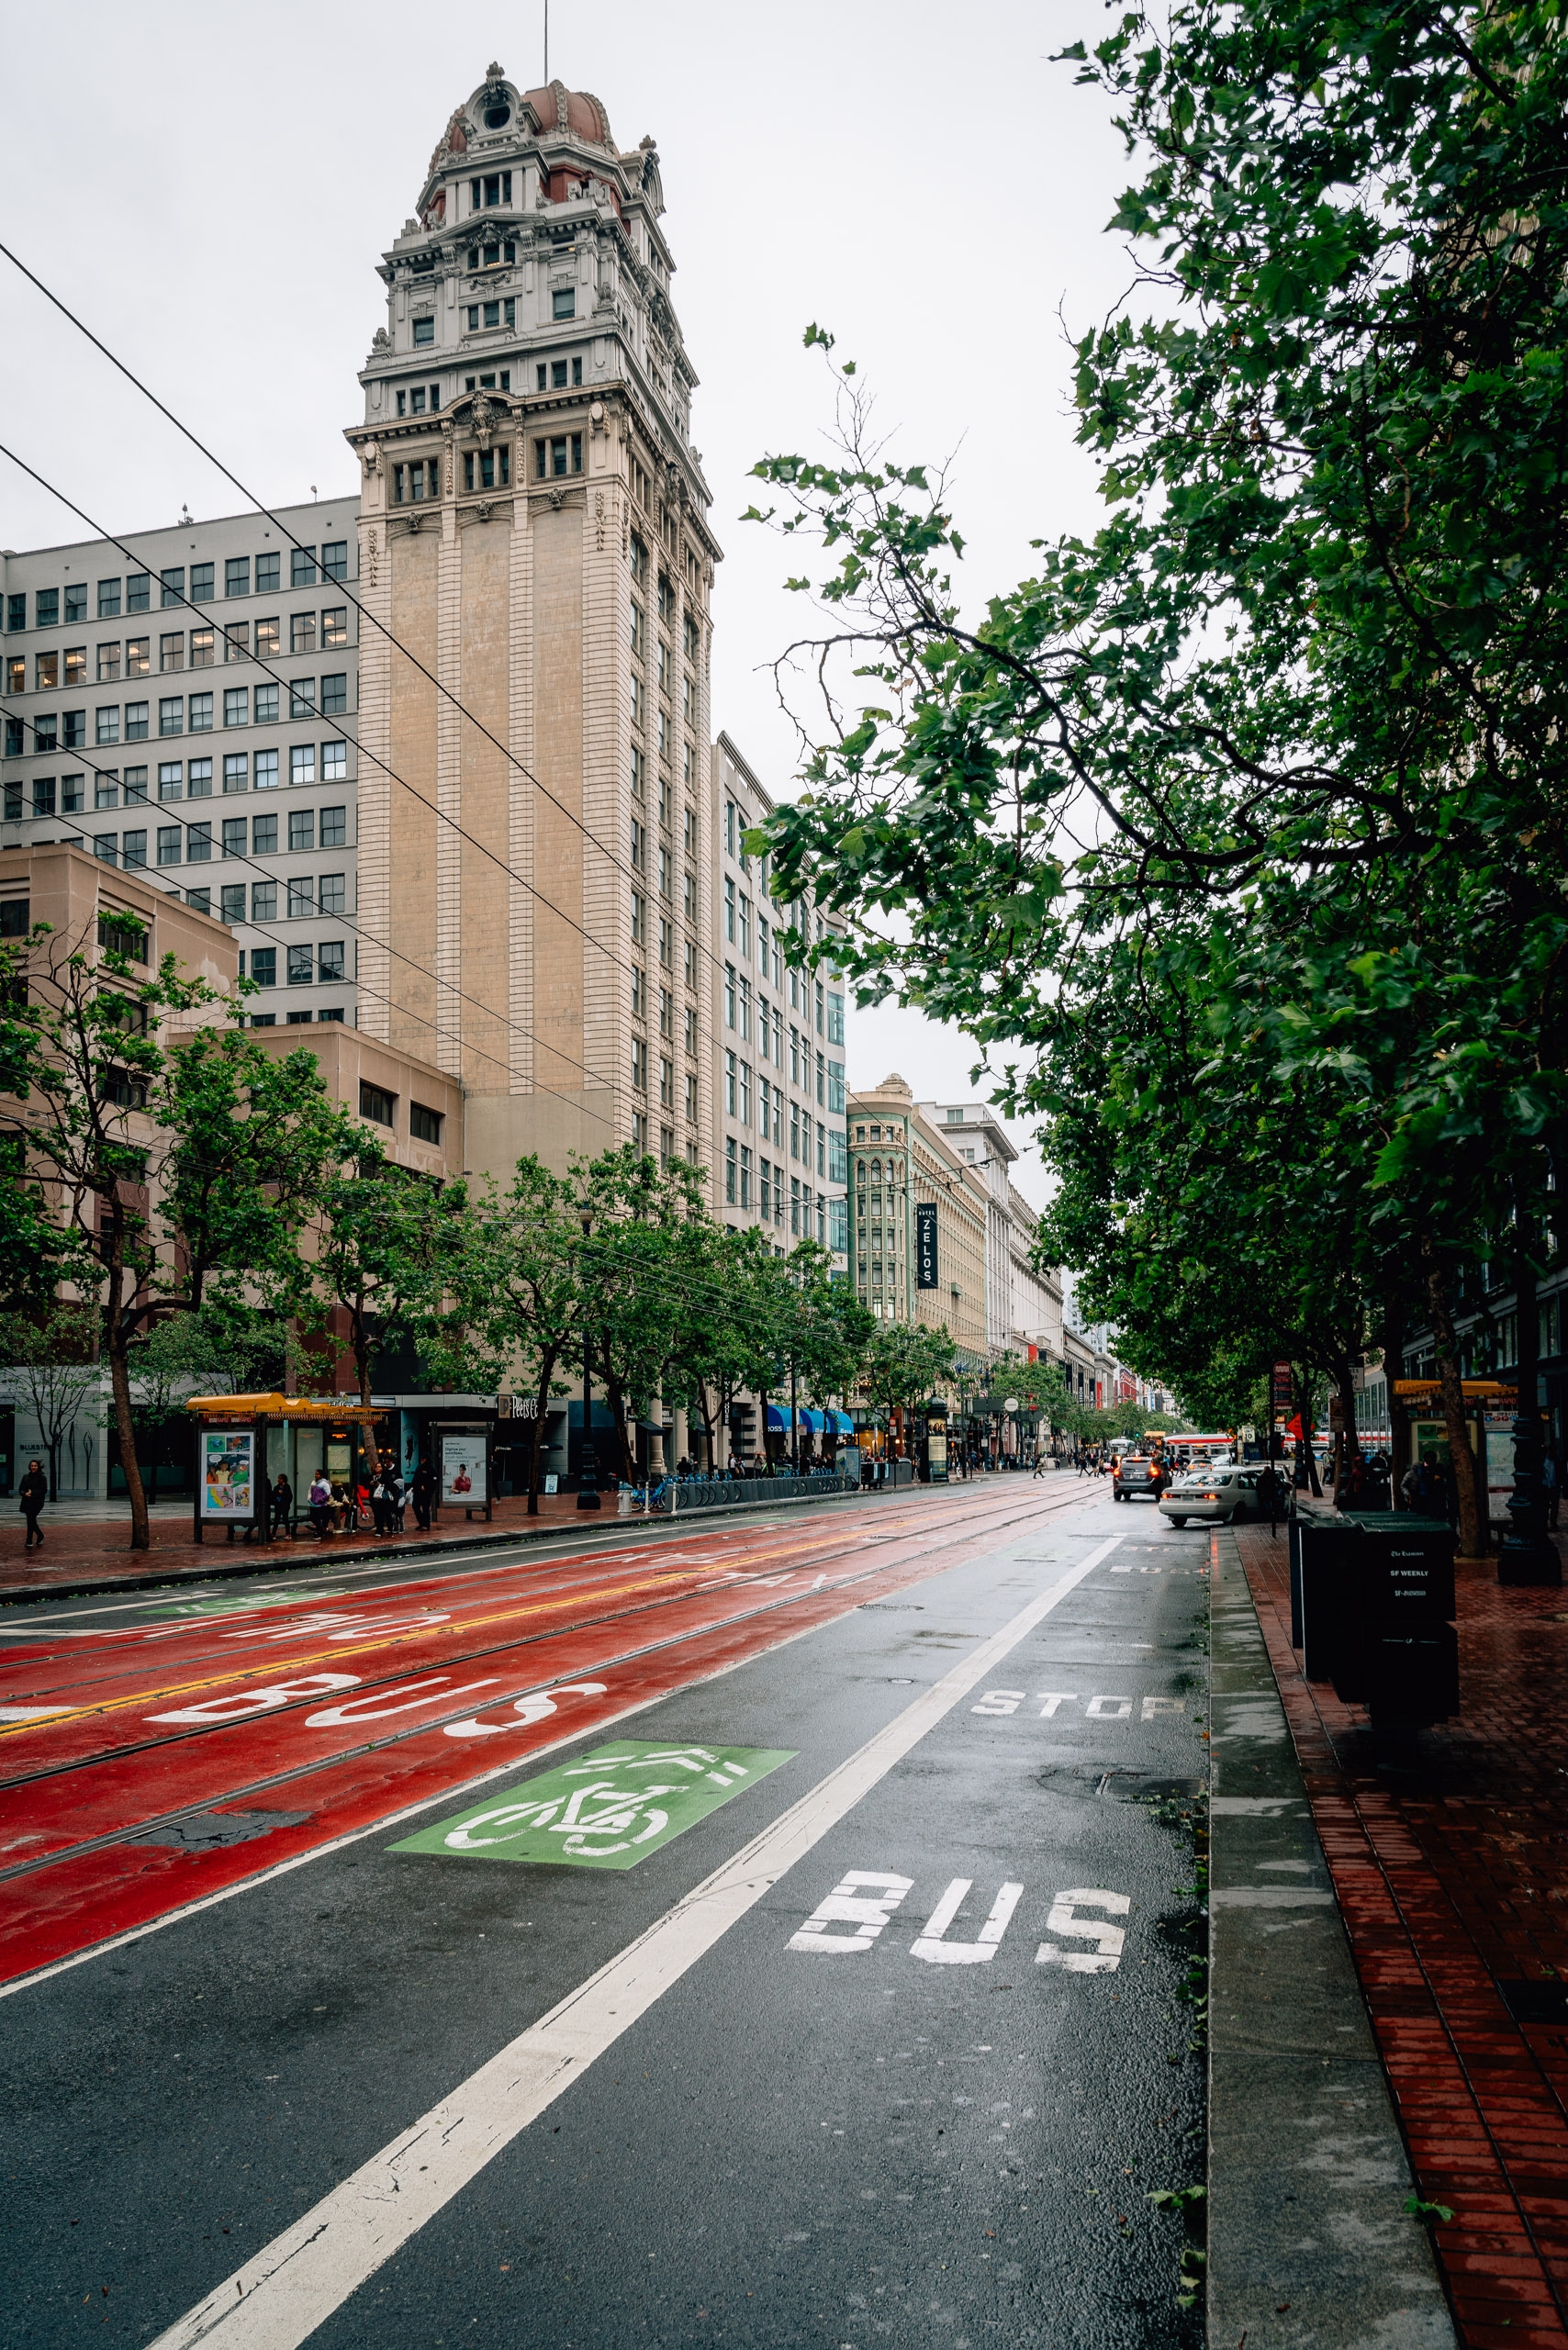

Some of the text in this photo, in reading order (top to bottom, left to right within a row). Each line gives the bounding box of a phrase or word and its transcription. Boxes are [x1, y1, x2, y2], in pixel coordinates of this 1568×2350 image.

[924, 1219, 932, 1281] ZELOS
[142, 1673, 609, 1738] BUS
[969, 1689, 1187, 1720] STOP
[783, 1870, 1131, 1974] BUS
